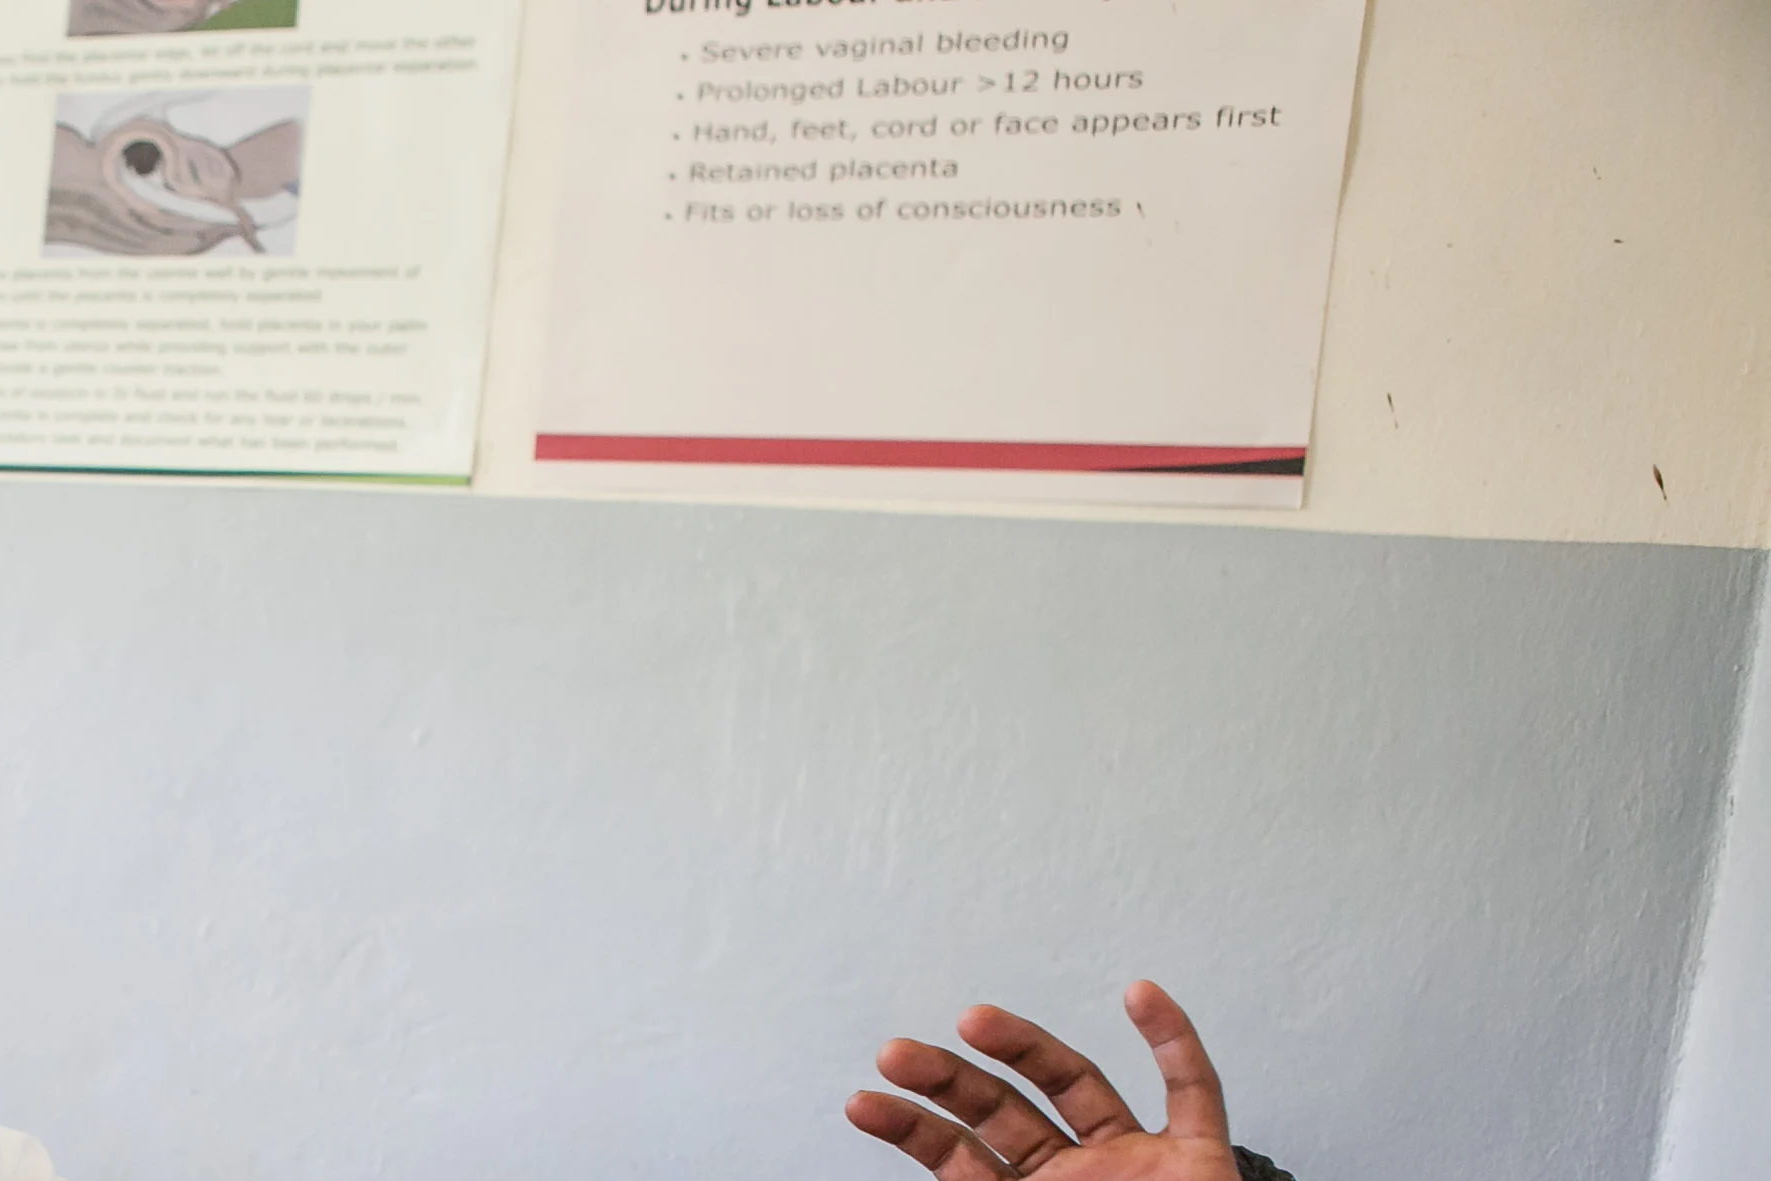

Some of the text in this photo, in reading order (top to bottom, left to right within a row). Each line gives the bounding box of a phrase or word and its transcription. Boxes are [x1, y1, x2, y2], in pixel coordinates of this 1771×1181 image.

[702, 29, 1069, 63] Severe vaginal bleeding
[697, 78, 844, 105] Prolonged
[857, 75, 963, 98] Labour
[1053, 69, 1143, 91] hours
[693, 105, 1282, 144] Hand, feet, cord or face appears first
[688, 158, 959, 183] Retained placenta
[685, 198, 1121, 222] Fits or loss of consciousness
